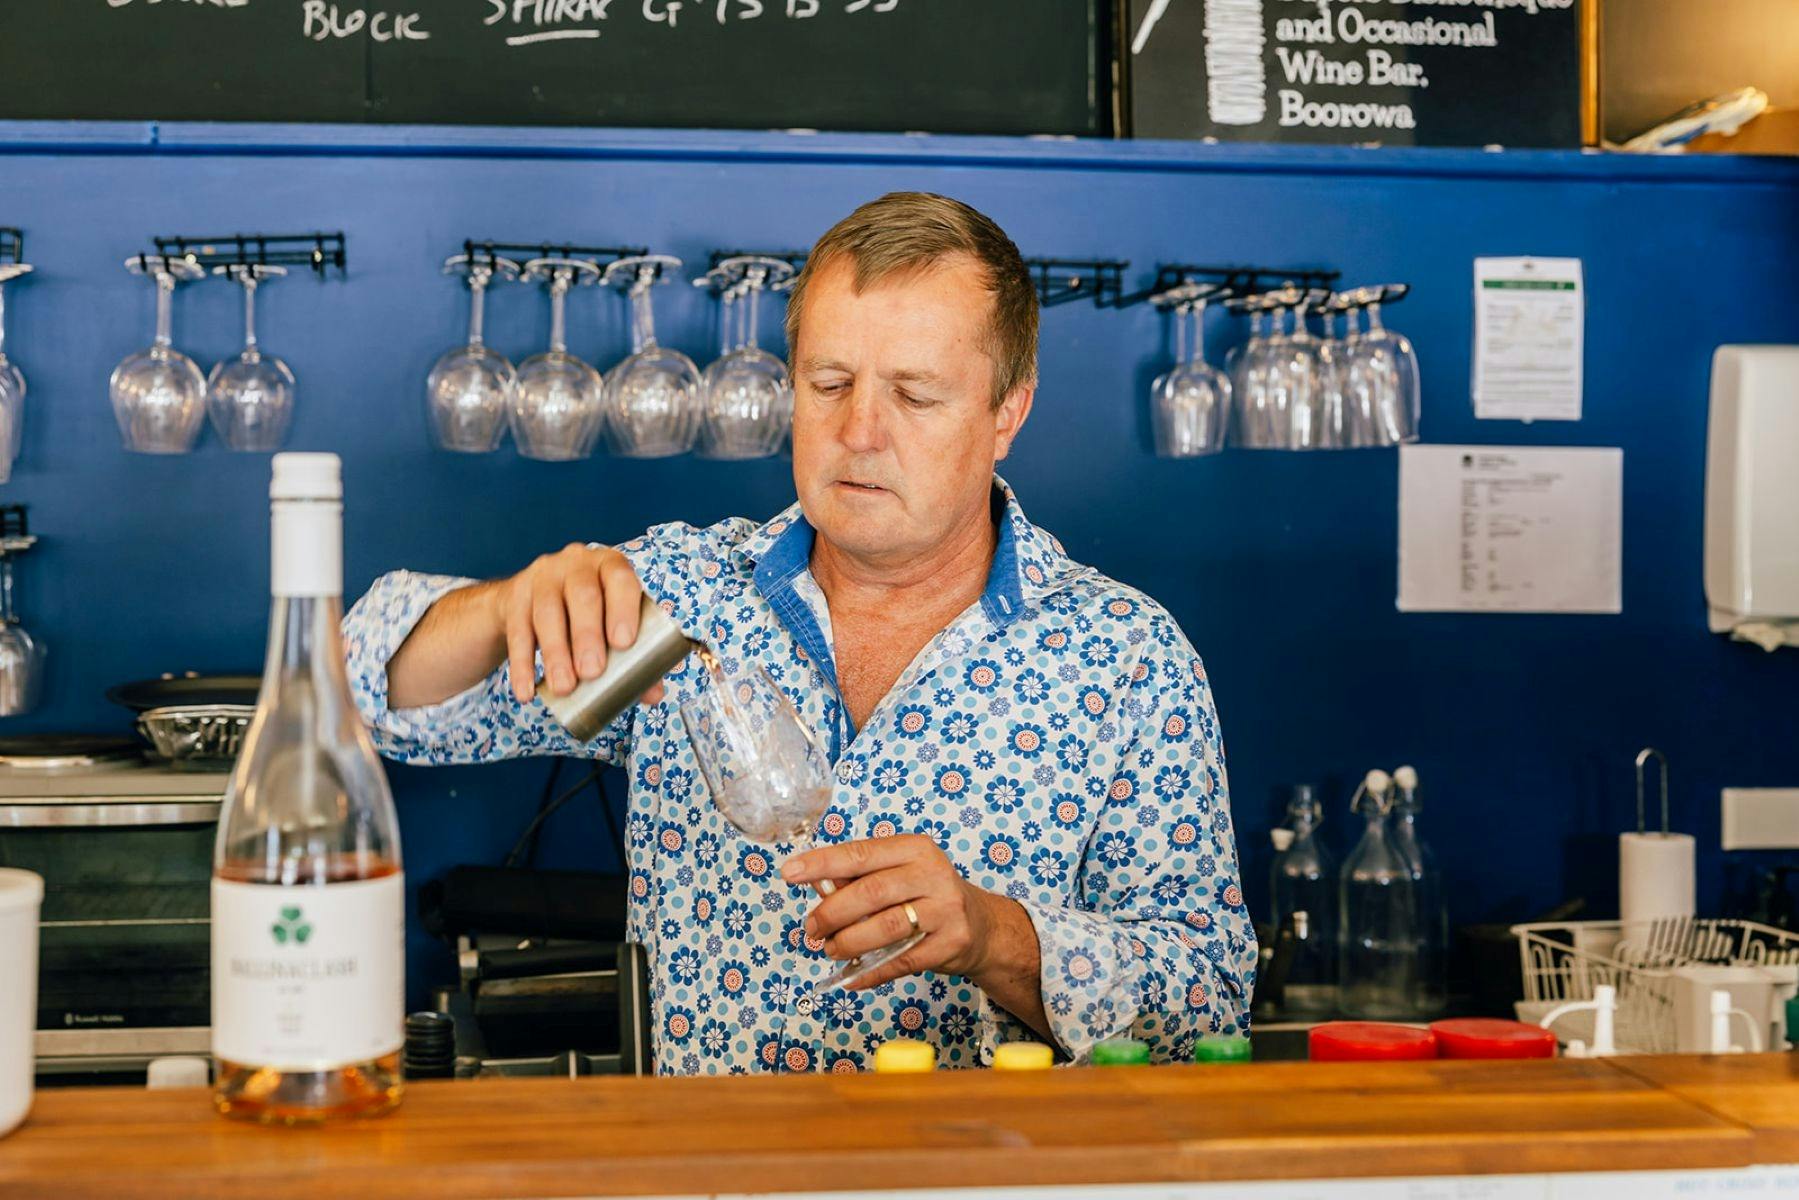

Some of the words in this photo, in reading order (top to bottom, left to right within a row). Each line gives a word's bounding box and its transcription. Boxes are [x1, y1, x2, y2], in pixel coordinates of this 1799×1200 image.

[1275, 7, 1335, 43] and
[1337, 7, 1497, 47] Occasional
[1275, 47, 1364, 86] Wine
[1278, 89, 1416, 129] Boorowa
